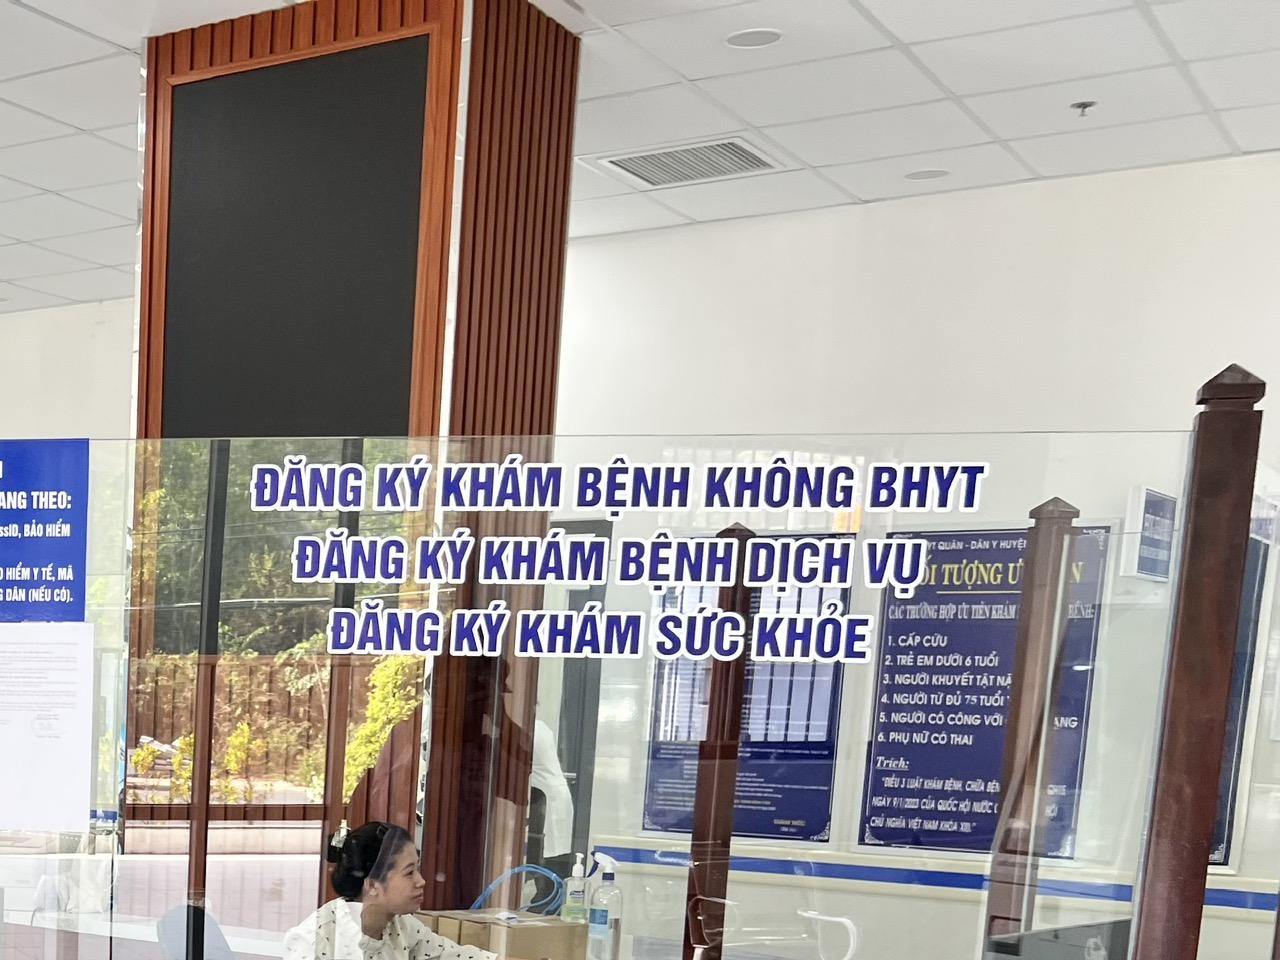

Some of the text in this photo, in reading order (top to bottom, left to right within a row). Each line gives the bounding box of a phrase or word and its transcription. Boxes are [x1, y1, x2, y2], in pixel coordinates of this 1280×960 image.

[254, 457, 985, 517] ĐĂNG KÝ KHÁM BỆNH KHÔNG BHYT
[31, 491, 72, 510] THEO:
[23, 519, 43, 537] BẢO
[46, 518, 70, 537] HIỂM
[992, 540, 998, 549] Y
[6, 561, 30, 580] HIỂM
[32, 567, 39, 580] Y
[41, 562, 56, 582] TẾ,
[57, 564, 74, 581] MÃ
[295, 530, 925, 596] ĐĂNG KÝ KHÁM BỆNH DỊCH VỤ
[942, 558, 1003, 590] TƯỢNG
[5, 585, 26, 601] DÂN
[28, 584, 51, 603] (NẾU
[53, 585, 73, 603] CÓ).
[888, 602, 905, 620] CÁC
[991, 600, 1017, 619] KHÁM
[330, 602, 870, 659] ĐĂNG KÝ KHÁM SỨC KHỎE
[888, 632, 948, 647] 1. CẤP CỨU
[885, 650, 999, 667] 2. TRẺ EM DƯỚI 6 TUỔI
[883, 674, 892, 685] 3.
[894, 671, 930, 686] NGƯỜI
[931, 670, 974, 687] KHUYẾT
[976, 672, 995, 689] TẬT
[881, 690, 1004, 707] 4. NGƯỜI TỪ ĐỦ 75 TUỔI
[879, 712, 888, 723] 5.
[891, 710, 926, 725] NGƯỜI
[928, 711, 945, 725] CÓ
[948, 711, 981, 726] CÔNG
[984, 711, 1003, 726] VỚI
[877, 730, 973, 746] 6. PHỤ NỮ CÓ THAI
[875, 756, 910, 770] Trích:
